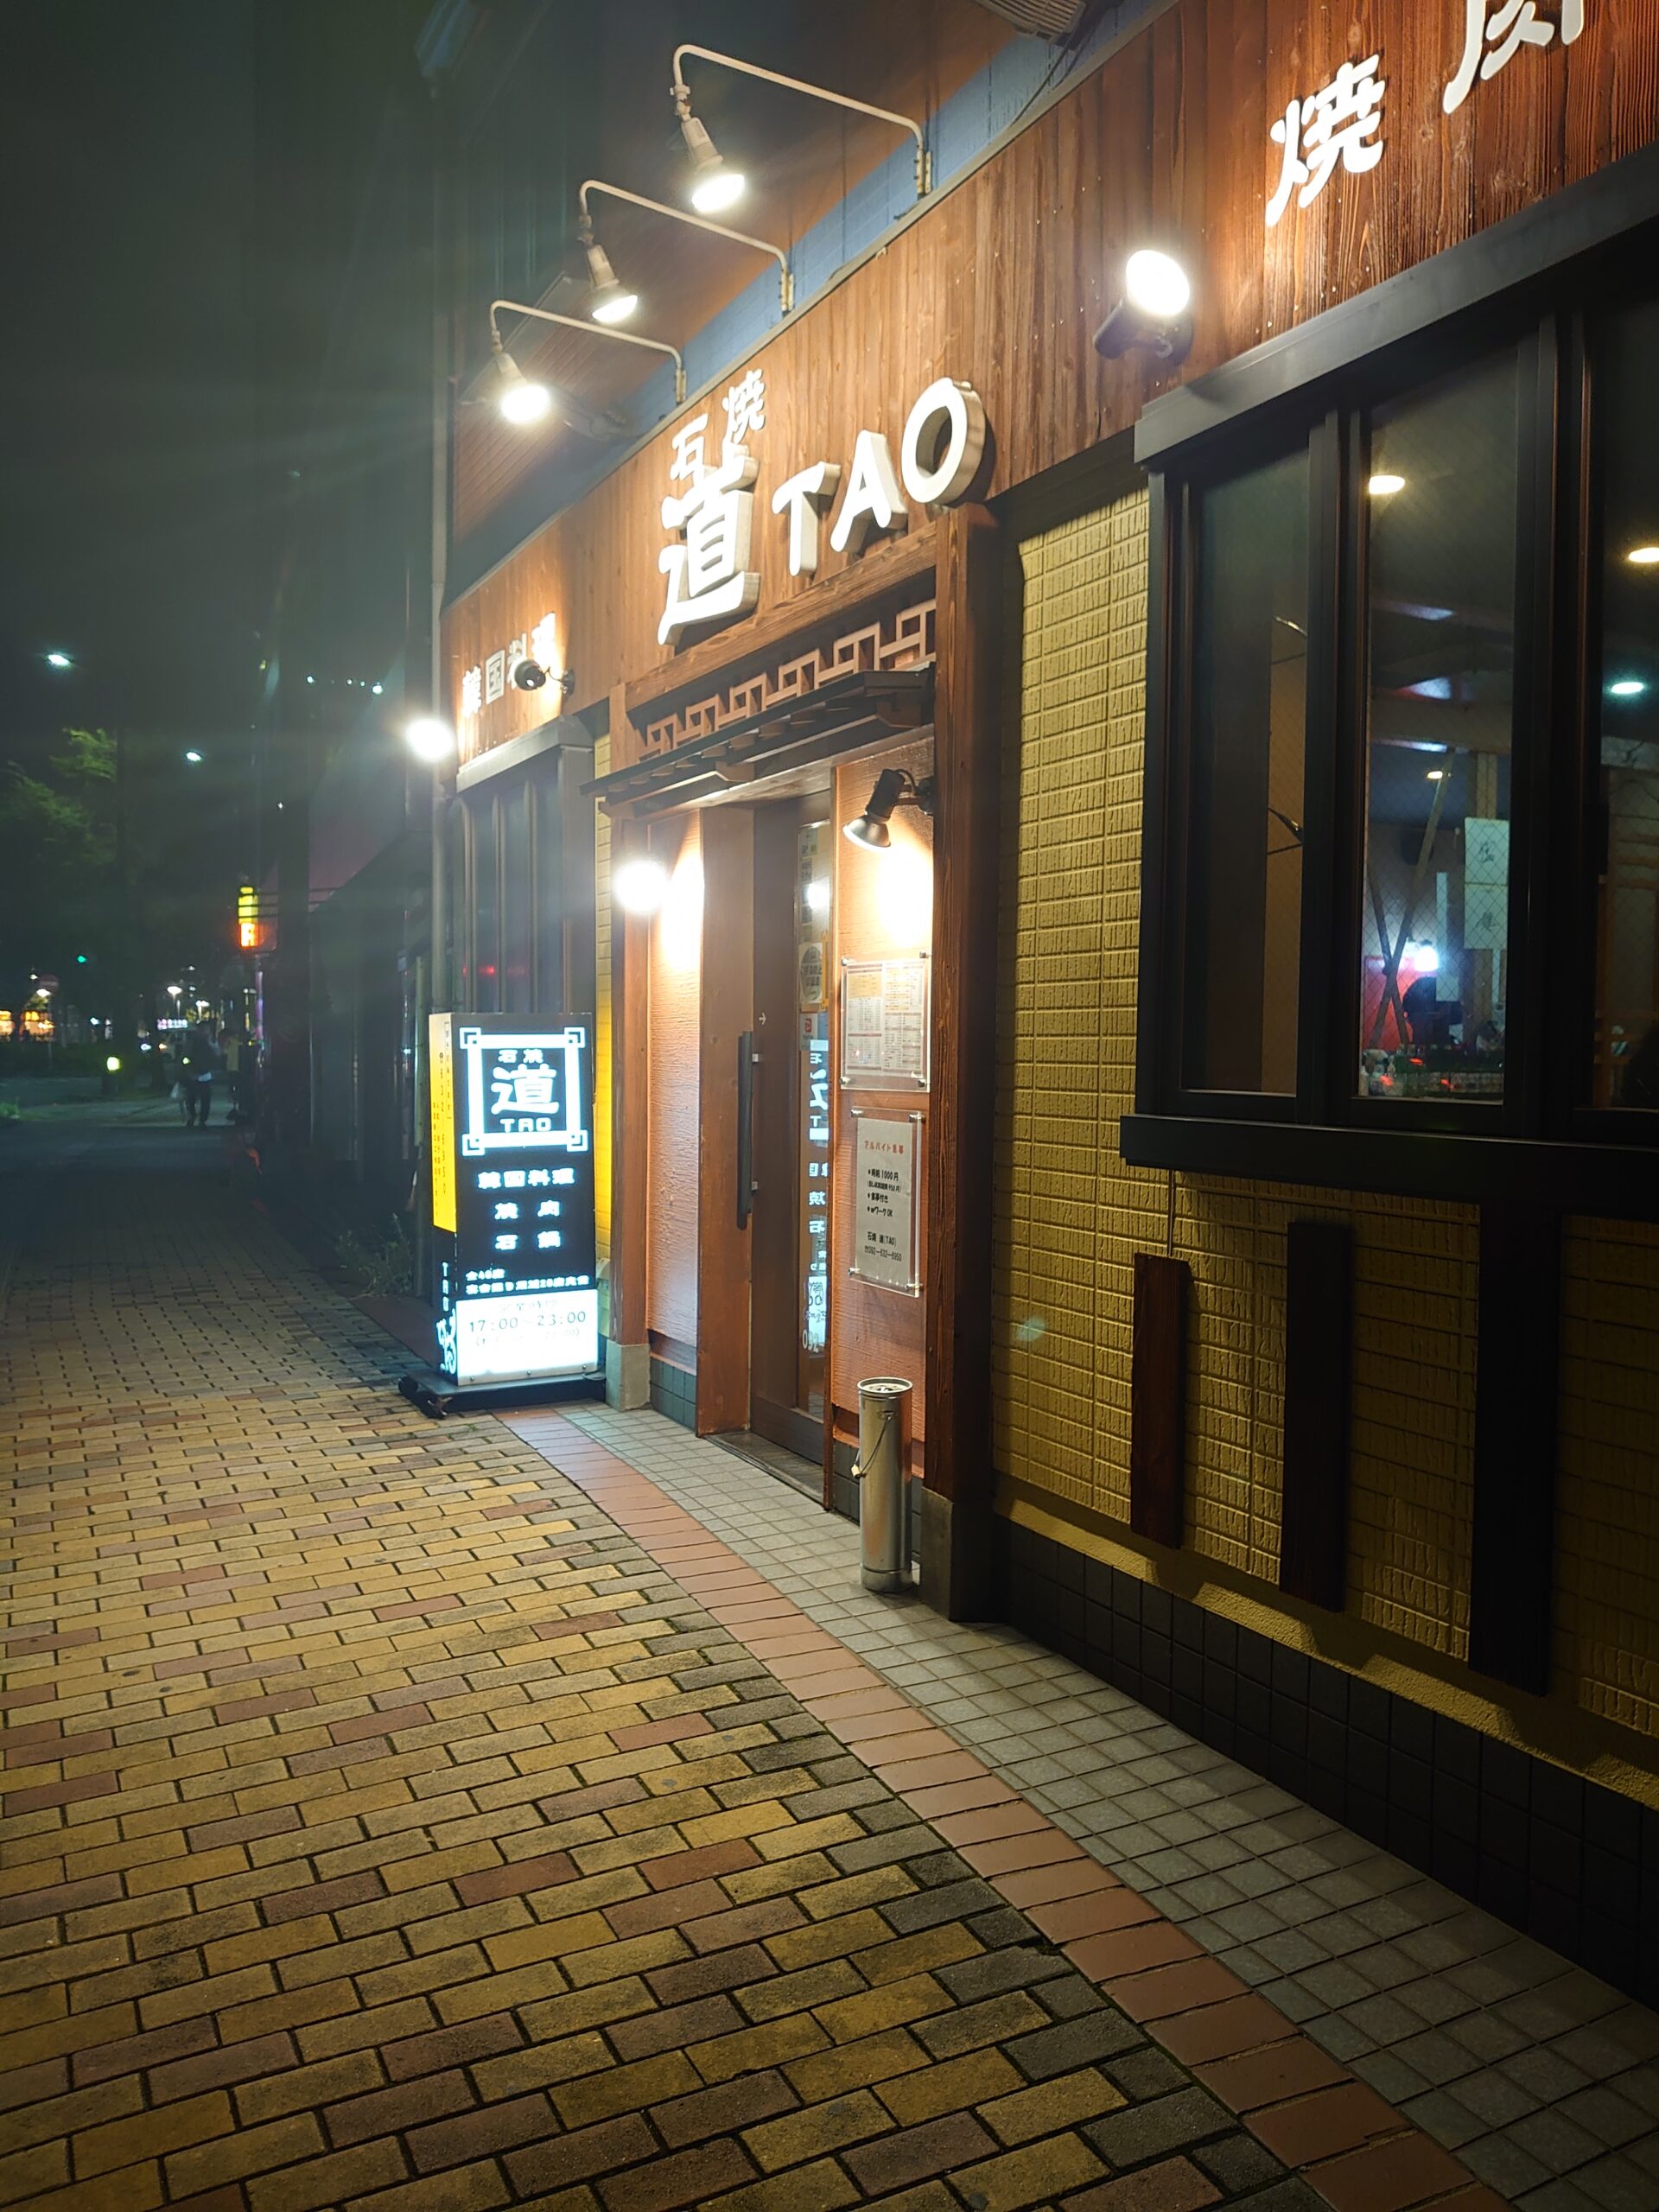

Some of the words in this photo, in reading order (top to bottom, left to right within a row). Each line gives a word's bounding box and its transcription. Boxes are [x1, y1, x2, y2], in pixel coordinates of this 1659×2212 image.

[670, 368, 766, 481] 石焼
[772, 377, 986, 577] TAO
[658, 435, 760, 645] 道
[491, 1063, 559, 1115] 道
[499, 1117, 551, 1133] TAO
[478, 1168, 575, 1189] 韓国料理
